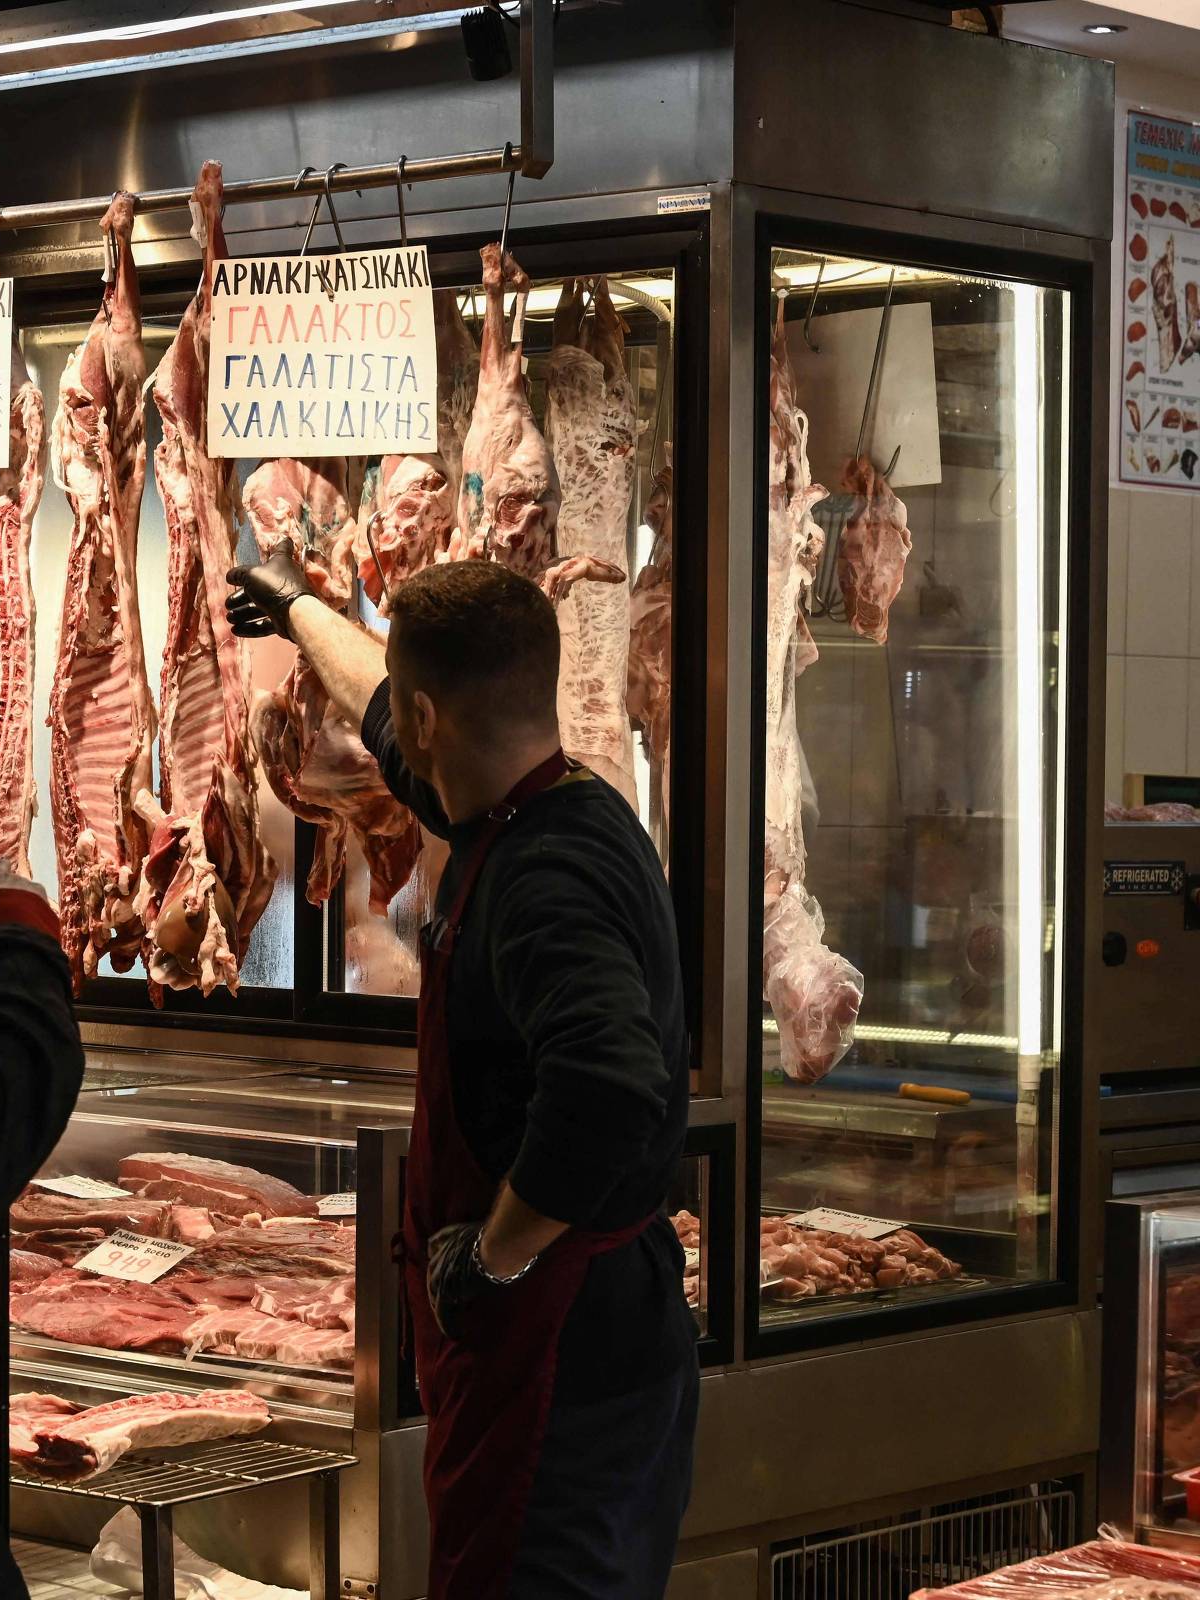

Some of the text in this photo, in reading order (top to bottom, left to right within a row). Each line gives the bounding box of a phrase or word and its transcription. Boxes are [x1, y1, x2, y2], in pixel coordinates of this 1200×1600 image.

[228, 299, 416, 344] ΓΑΛΑΚΤΟΣ
[224, 353, 418, 393] ΓΑΛΑΤΙΣΤΑ
[221, 400, 432, 440] ΧΑΛΚΙΔΙΚΗΣ
[1112, 869, 1169, 883] REFRIGERATED
